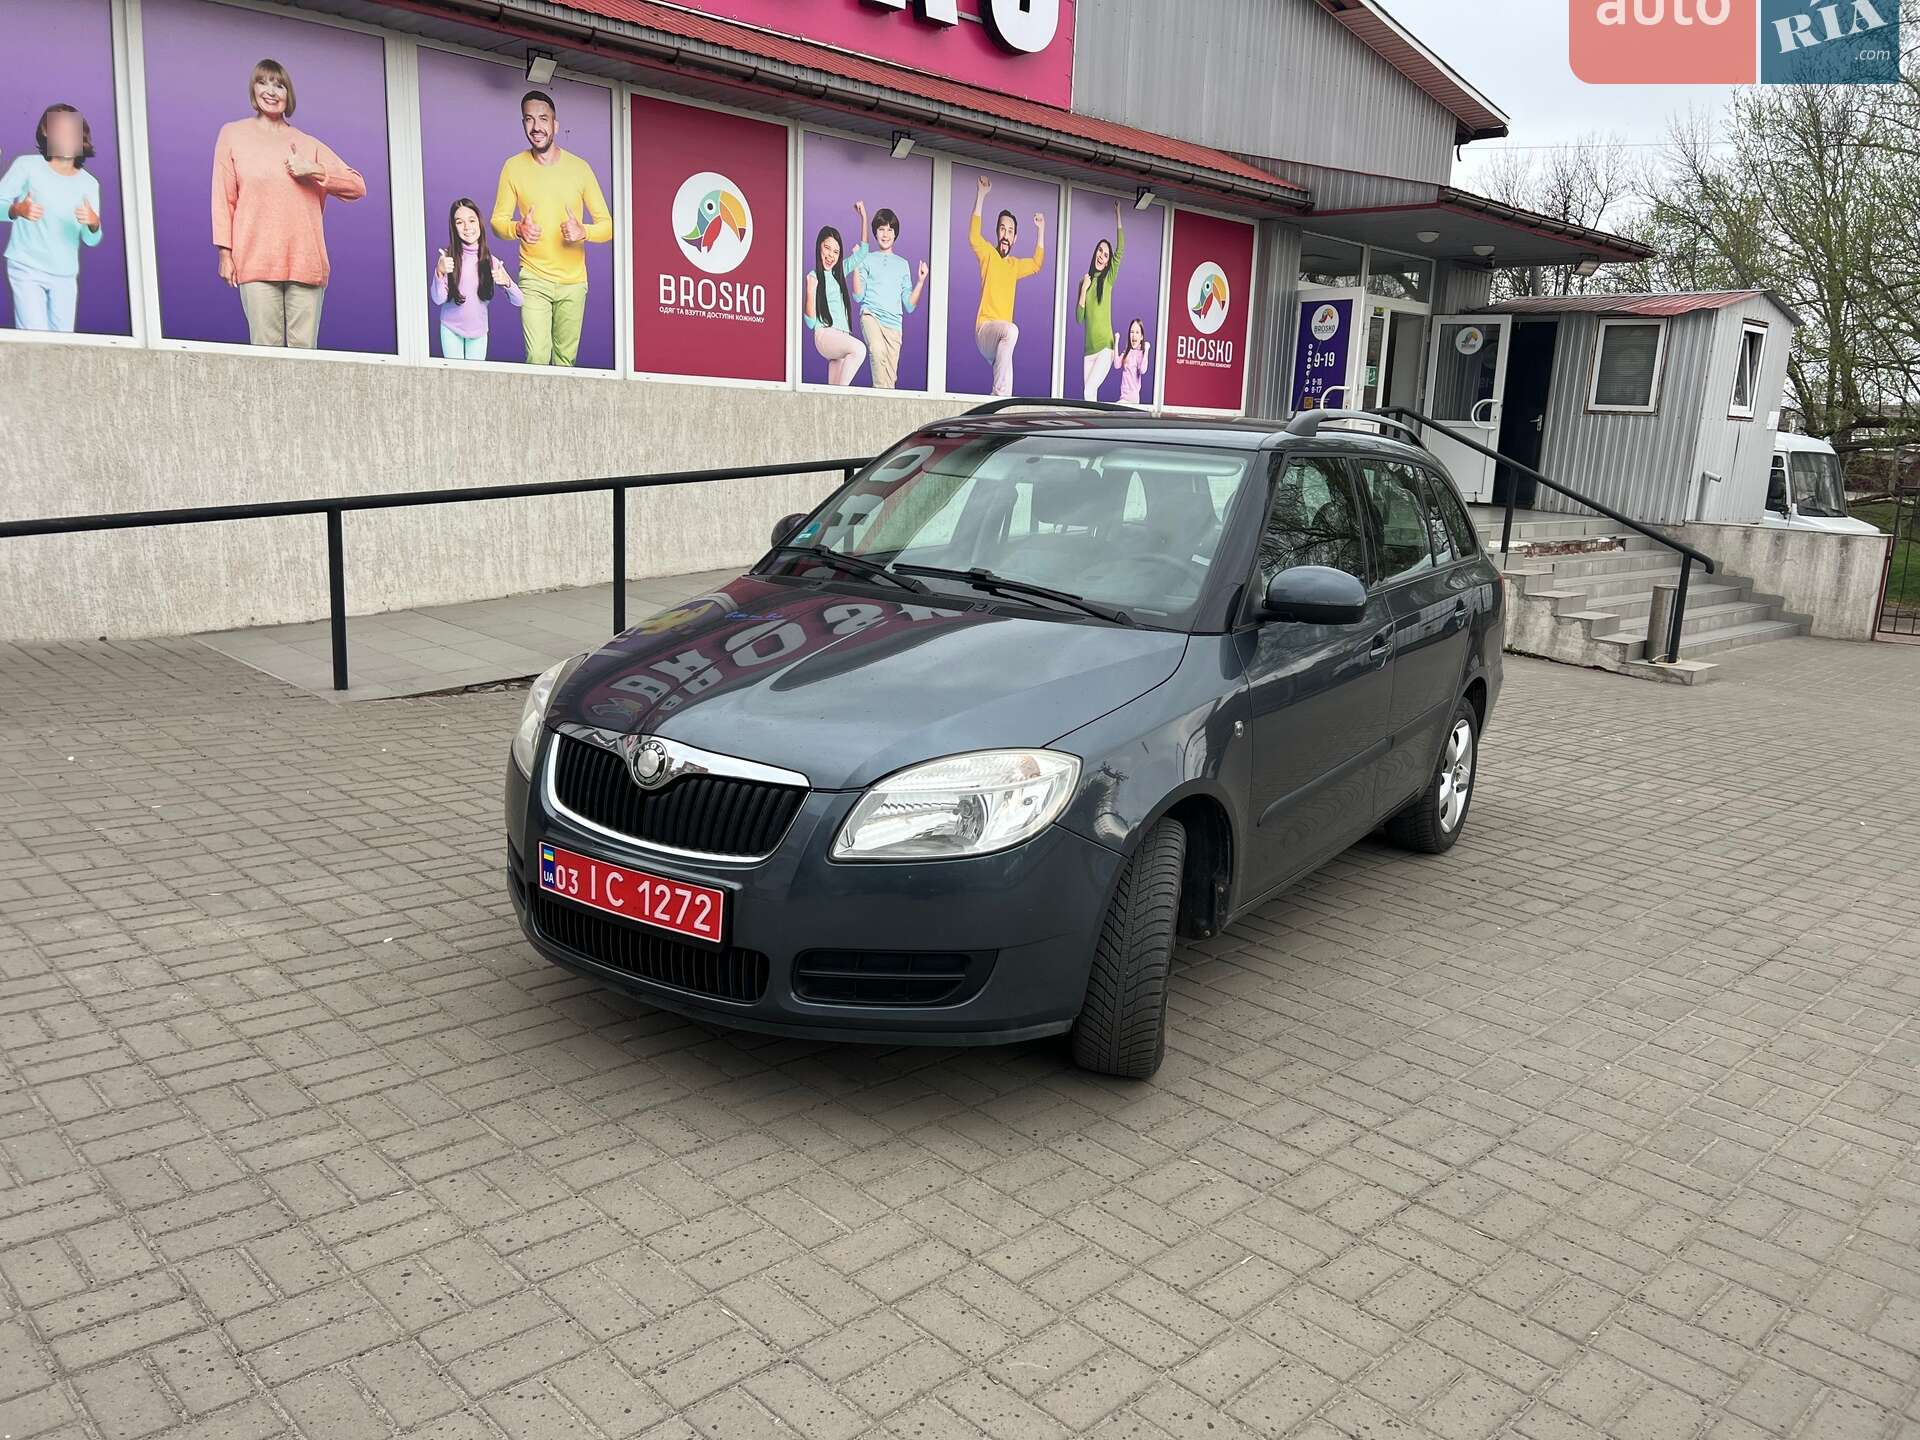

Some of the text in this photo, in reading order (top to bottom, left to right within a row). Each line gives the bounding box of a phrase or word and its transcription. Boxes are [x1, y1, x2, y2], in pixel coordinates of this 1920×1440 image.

[659, 274, 765, 315] BROSKO
[659, 306, 676, 314] ОДЯГ
[685, 309, 706, 317] ВЗУТТЯ
[1177, 336, 1233, 363] BROSKO
[1314, 352, 1335, 367] 9-19
[543, 870, 555, 884] UA
[555, 864, 579, 895] 03
[637, 880, 713, 932] 1272
